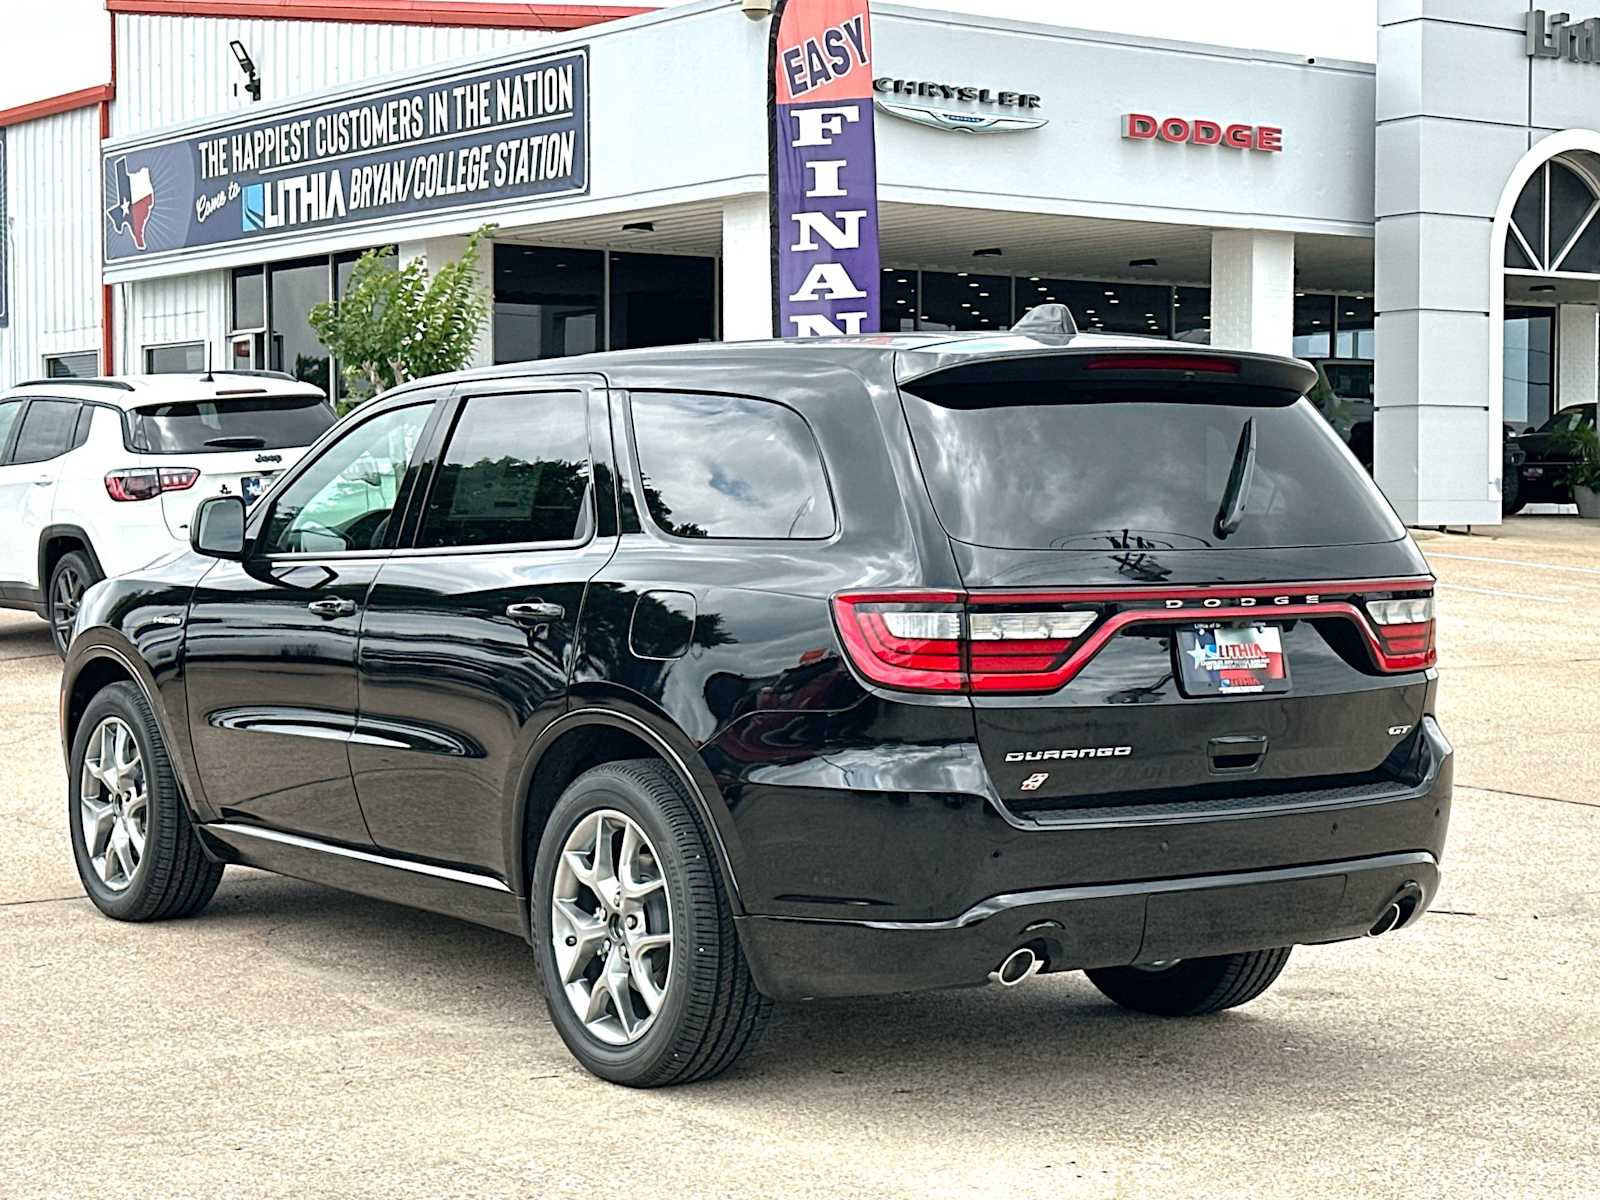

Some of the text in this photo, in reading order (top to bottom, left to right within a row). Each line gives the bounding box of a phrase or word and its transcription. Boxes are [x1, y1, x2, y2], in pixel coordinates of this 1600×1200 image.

[783, 14, 869, 98] EASY
[873, 77, 1041, 109] CHRYSLER
[198, 64, 574, 180] THE HAPPIEST CUSTOMERS IN THE NATION
[1121, 112, 1283, 153] DODGE
[195, 130, 576, 229] Come to LITHIA BRYAN/COLLEGE STATION
[1165, 594, 1320, 609] DODGE
[1217, 643, 1267, 660] LITHIA
[1387, 724, 1412, 735] GT
[1004, 746, 1133, 762] DURANGO
